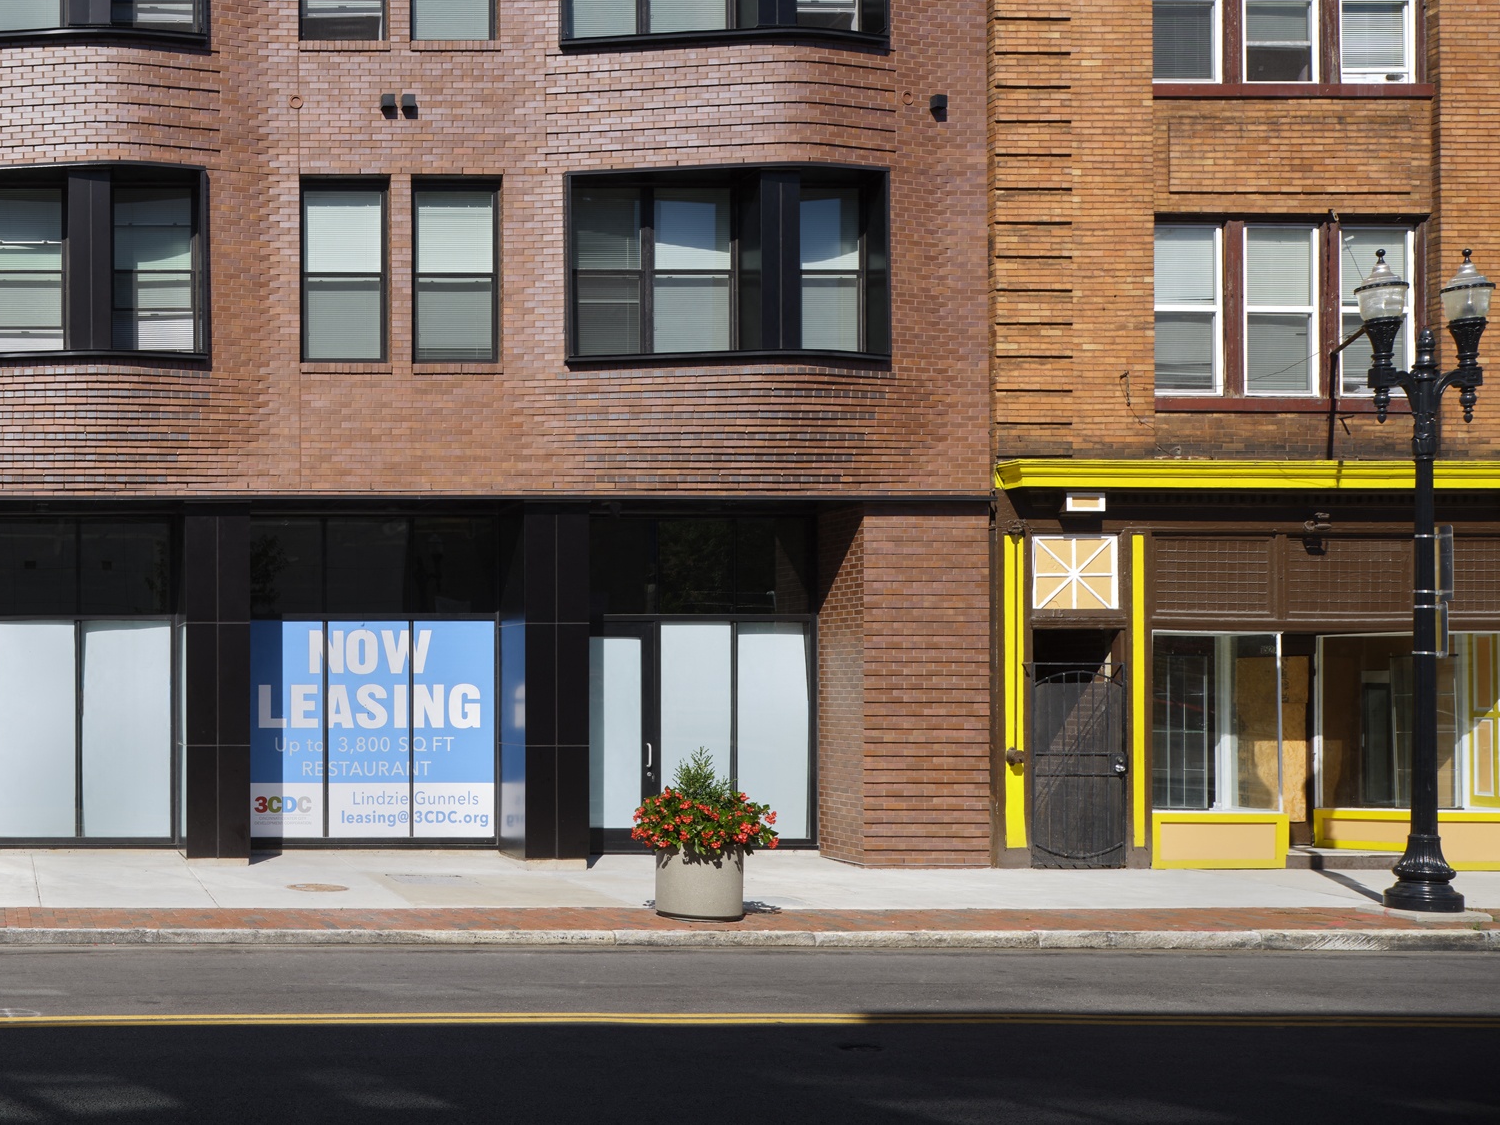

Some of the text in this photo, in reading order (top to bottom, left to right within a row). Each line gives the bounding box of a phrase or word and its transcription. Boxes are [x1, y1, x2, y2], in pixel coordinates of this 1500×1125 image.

[308, 629, 432, 675] NOW
[258, 683, 481, 729] LEASING
[274, 736, 455, 756] Up to 3,800 SQ FT
[301, 760, 432, 777] RESTAURANT
[254, 796, 312, 813] 3CDC
[352, 791, 479, 806] Lindzie Gunnels
[341, 810, 489, 827] leasing@3CDC.org
